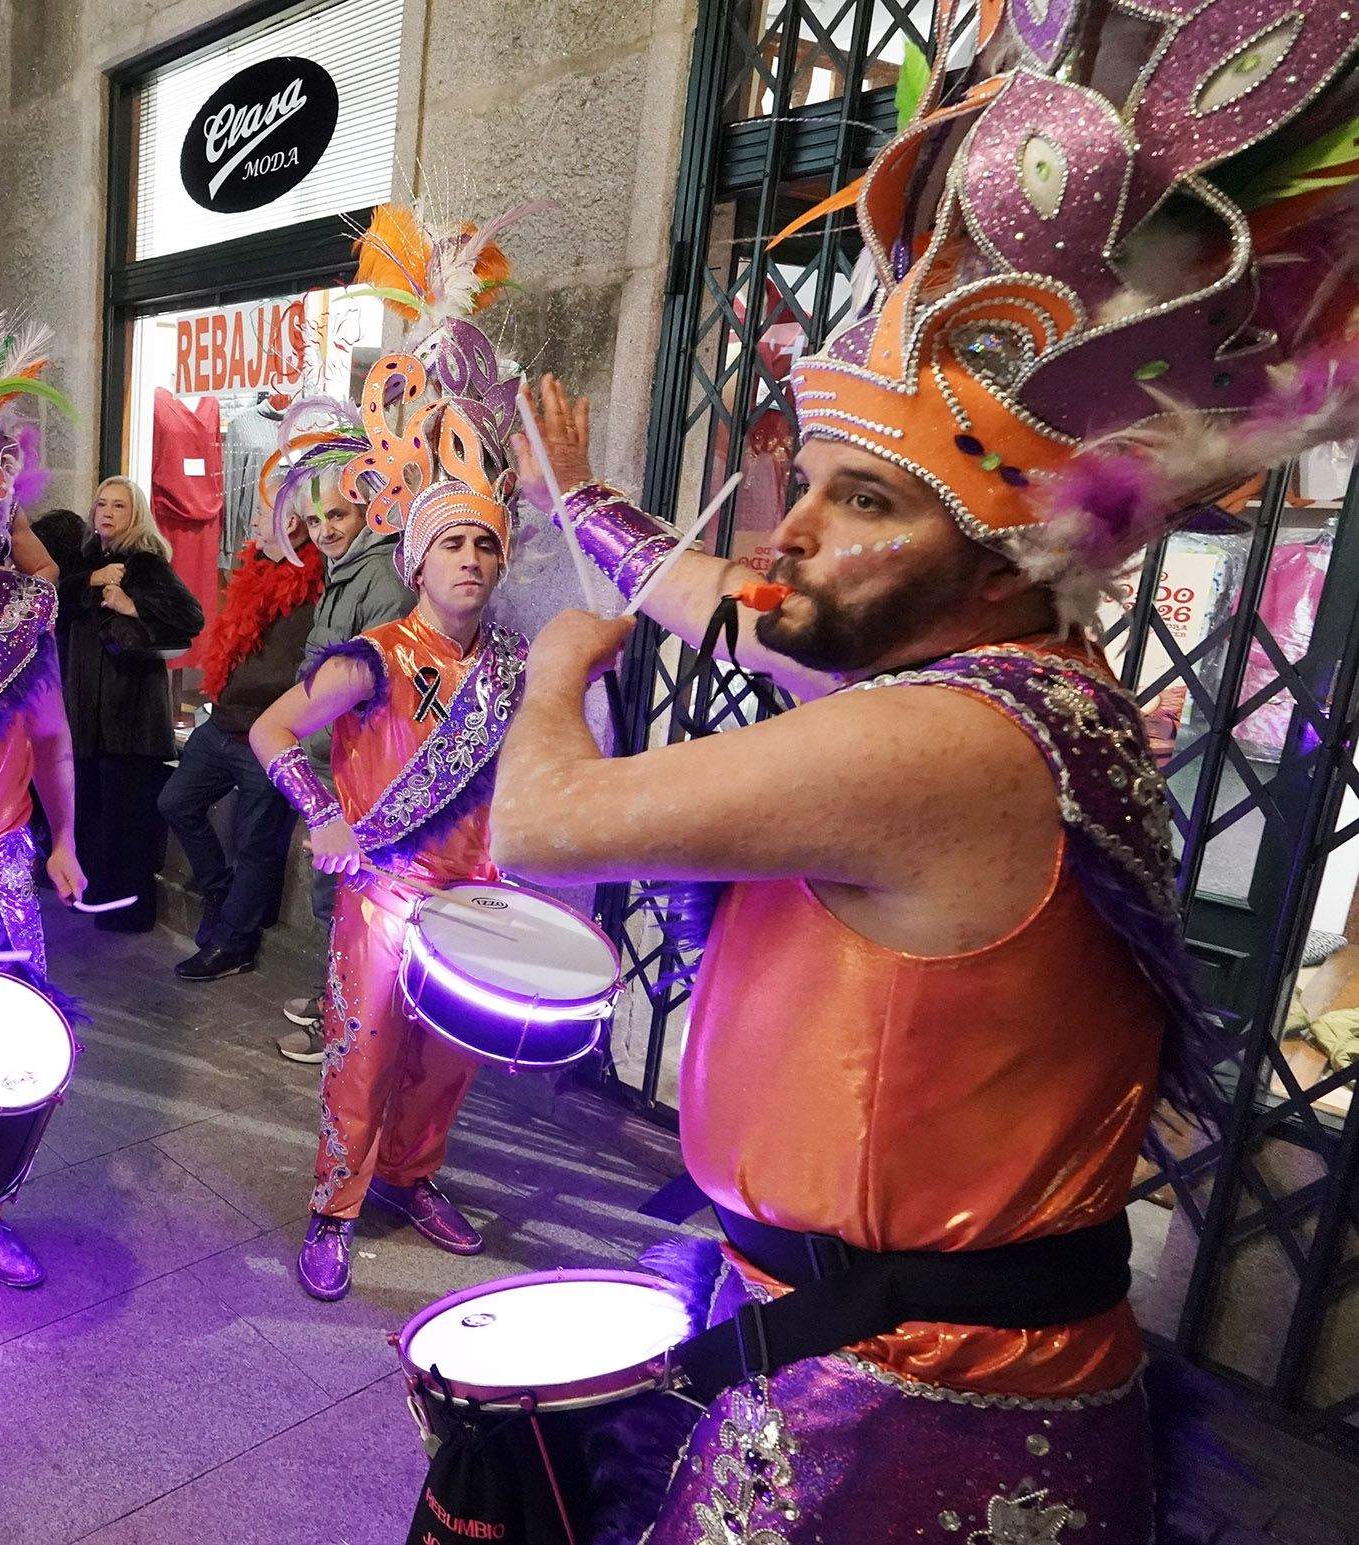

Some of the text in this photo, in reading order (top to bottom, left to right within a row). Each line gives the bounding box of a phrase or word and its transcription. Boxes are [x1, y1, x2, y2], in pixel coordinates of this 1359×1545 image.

[203, 77, 308, 164] Clasa
[242, 147, 300, 180] MODA
[176, 300, 306, 393] REBAJAS
